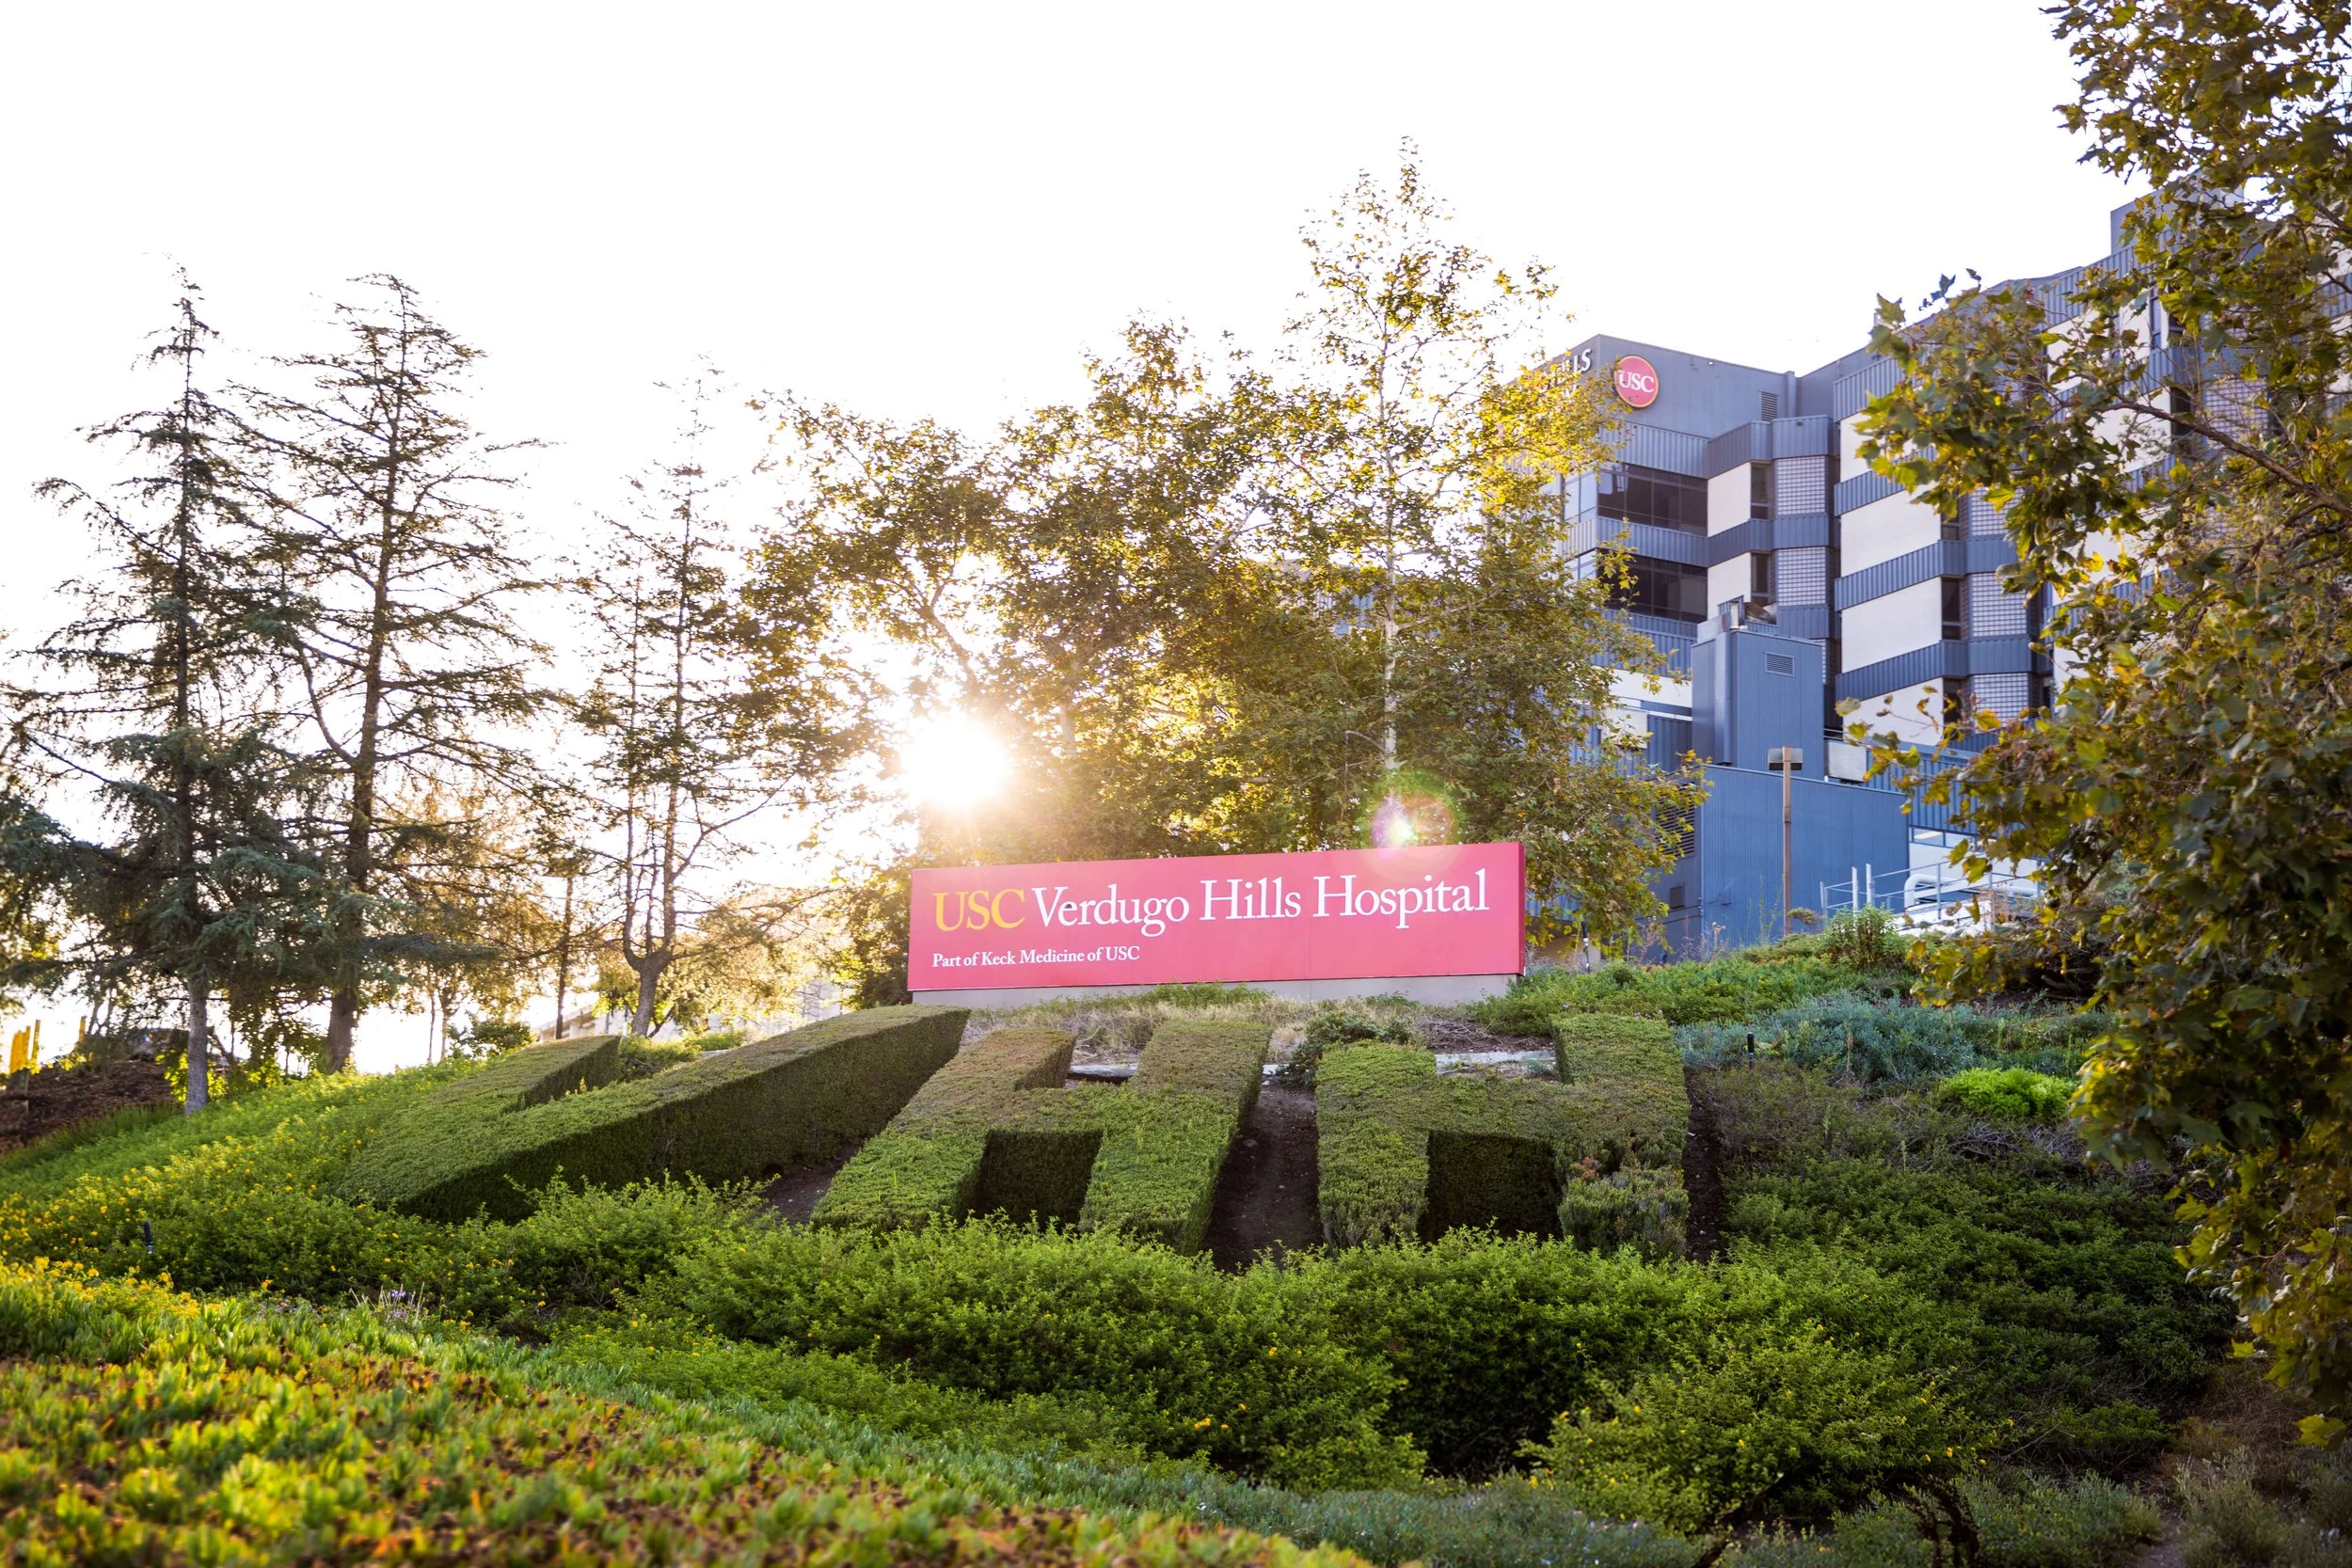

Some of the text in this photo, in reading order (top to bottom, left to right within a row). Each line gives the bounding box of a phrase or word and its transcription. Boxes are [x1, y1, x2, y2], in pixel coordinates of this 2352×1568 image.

[1618, 370, 1655, 393] USC
[932, 867, 1490, 938] USC Verdugo Hills Hospital
[932, 945, 1140, 968] Part of Keck Medicine of USC
